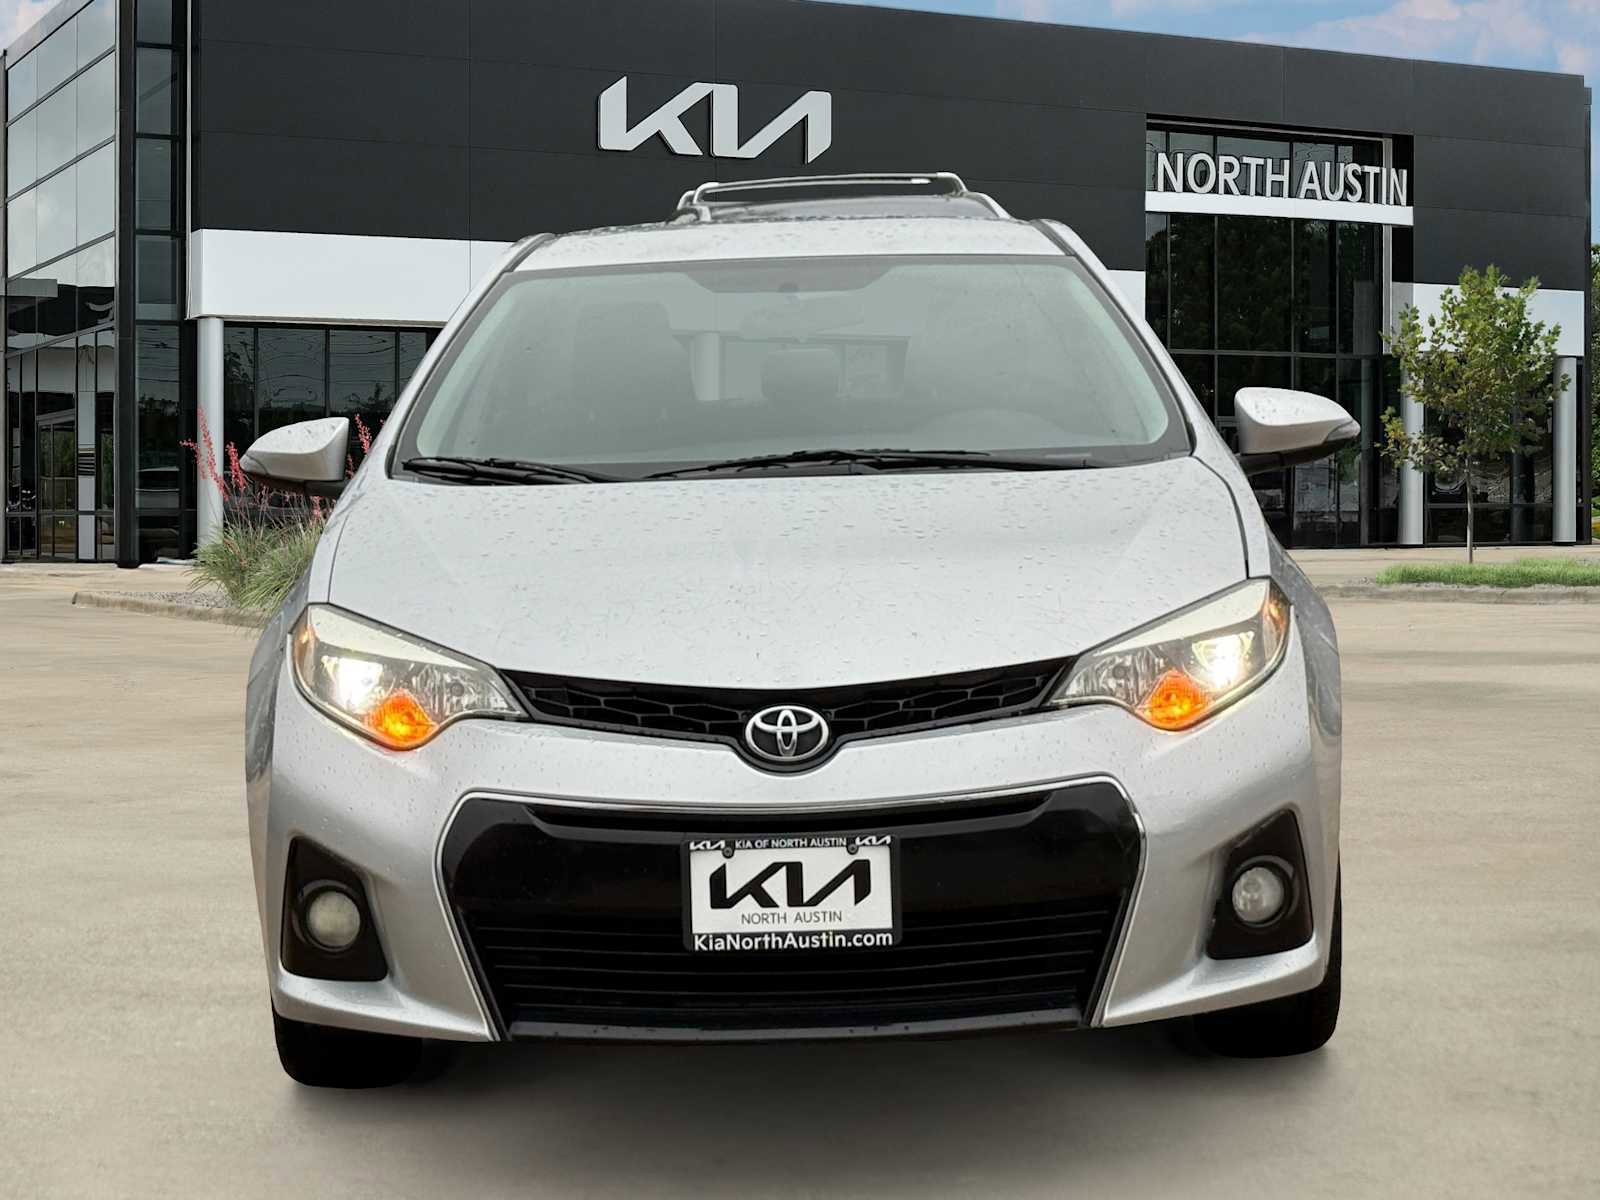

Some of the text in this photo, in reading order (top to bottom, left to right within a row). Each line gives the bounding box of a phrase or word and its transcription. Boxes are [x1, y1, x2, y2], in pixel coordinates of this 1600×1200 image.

[598, 76, 832, 165] KIA
[1156, 152, 1407, 206] NORTH AUSTIN
[735, 837, 846, 849] KIA OF NORTH AUSTIN
[710, 859, 871, 909] KIA
[741, 911, 842, 925] NORTH AUSTIN
[694, 932, 893, 951] KiaNorthAustin.com
